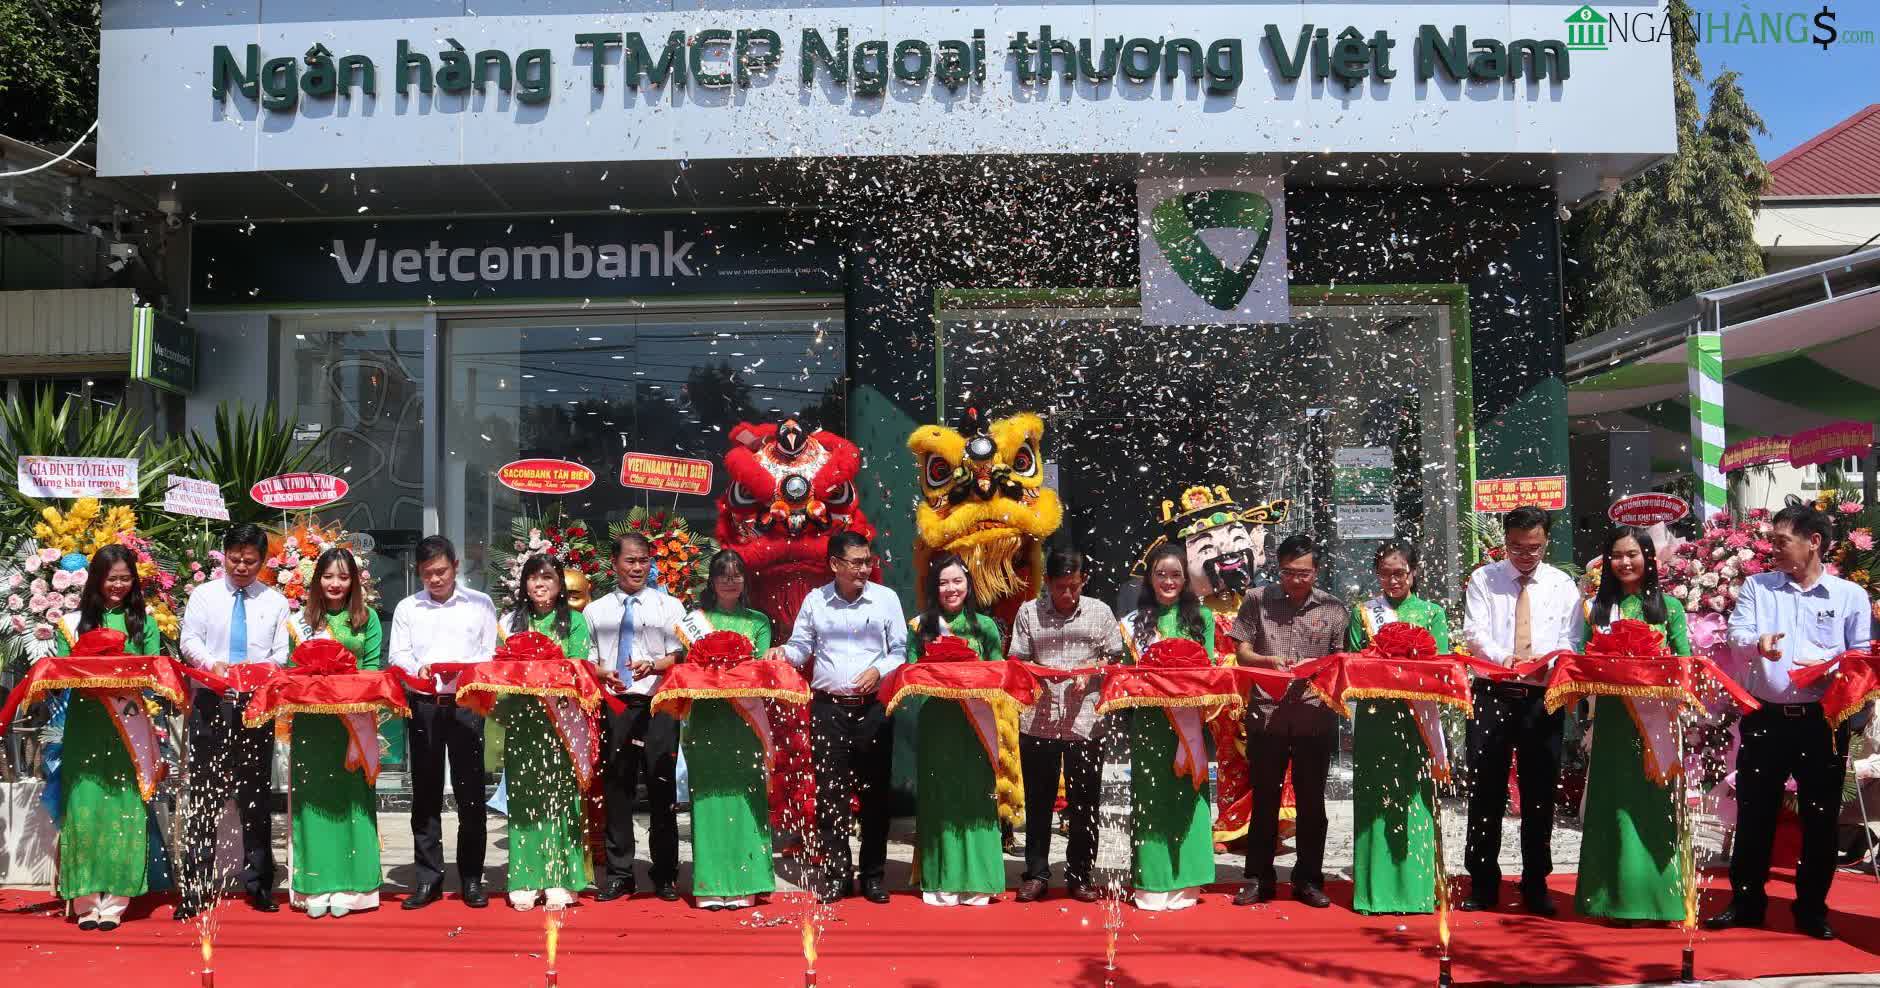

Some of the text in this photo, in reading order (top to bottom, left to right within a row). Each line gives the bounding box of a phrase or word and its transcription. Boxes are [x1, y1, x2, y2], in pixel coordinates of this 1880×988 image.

[211, 23, 1571, 111] Ngân hàng TMCP Ngoại thương Việt Nam
[332, 230, 696, 284] Vietcombank
[29, 462, 48, 477] GIA
[503, 468, 551, 479] SACOMBANK
[628, 458, 673, 476] VIETINBANK
[64, 477, 86, 488] khai
